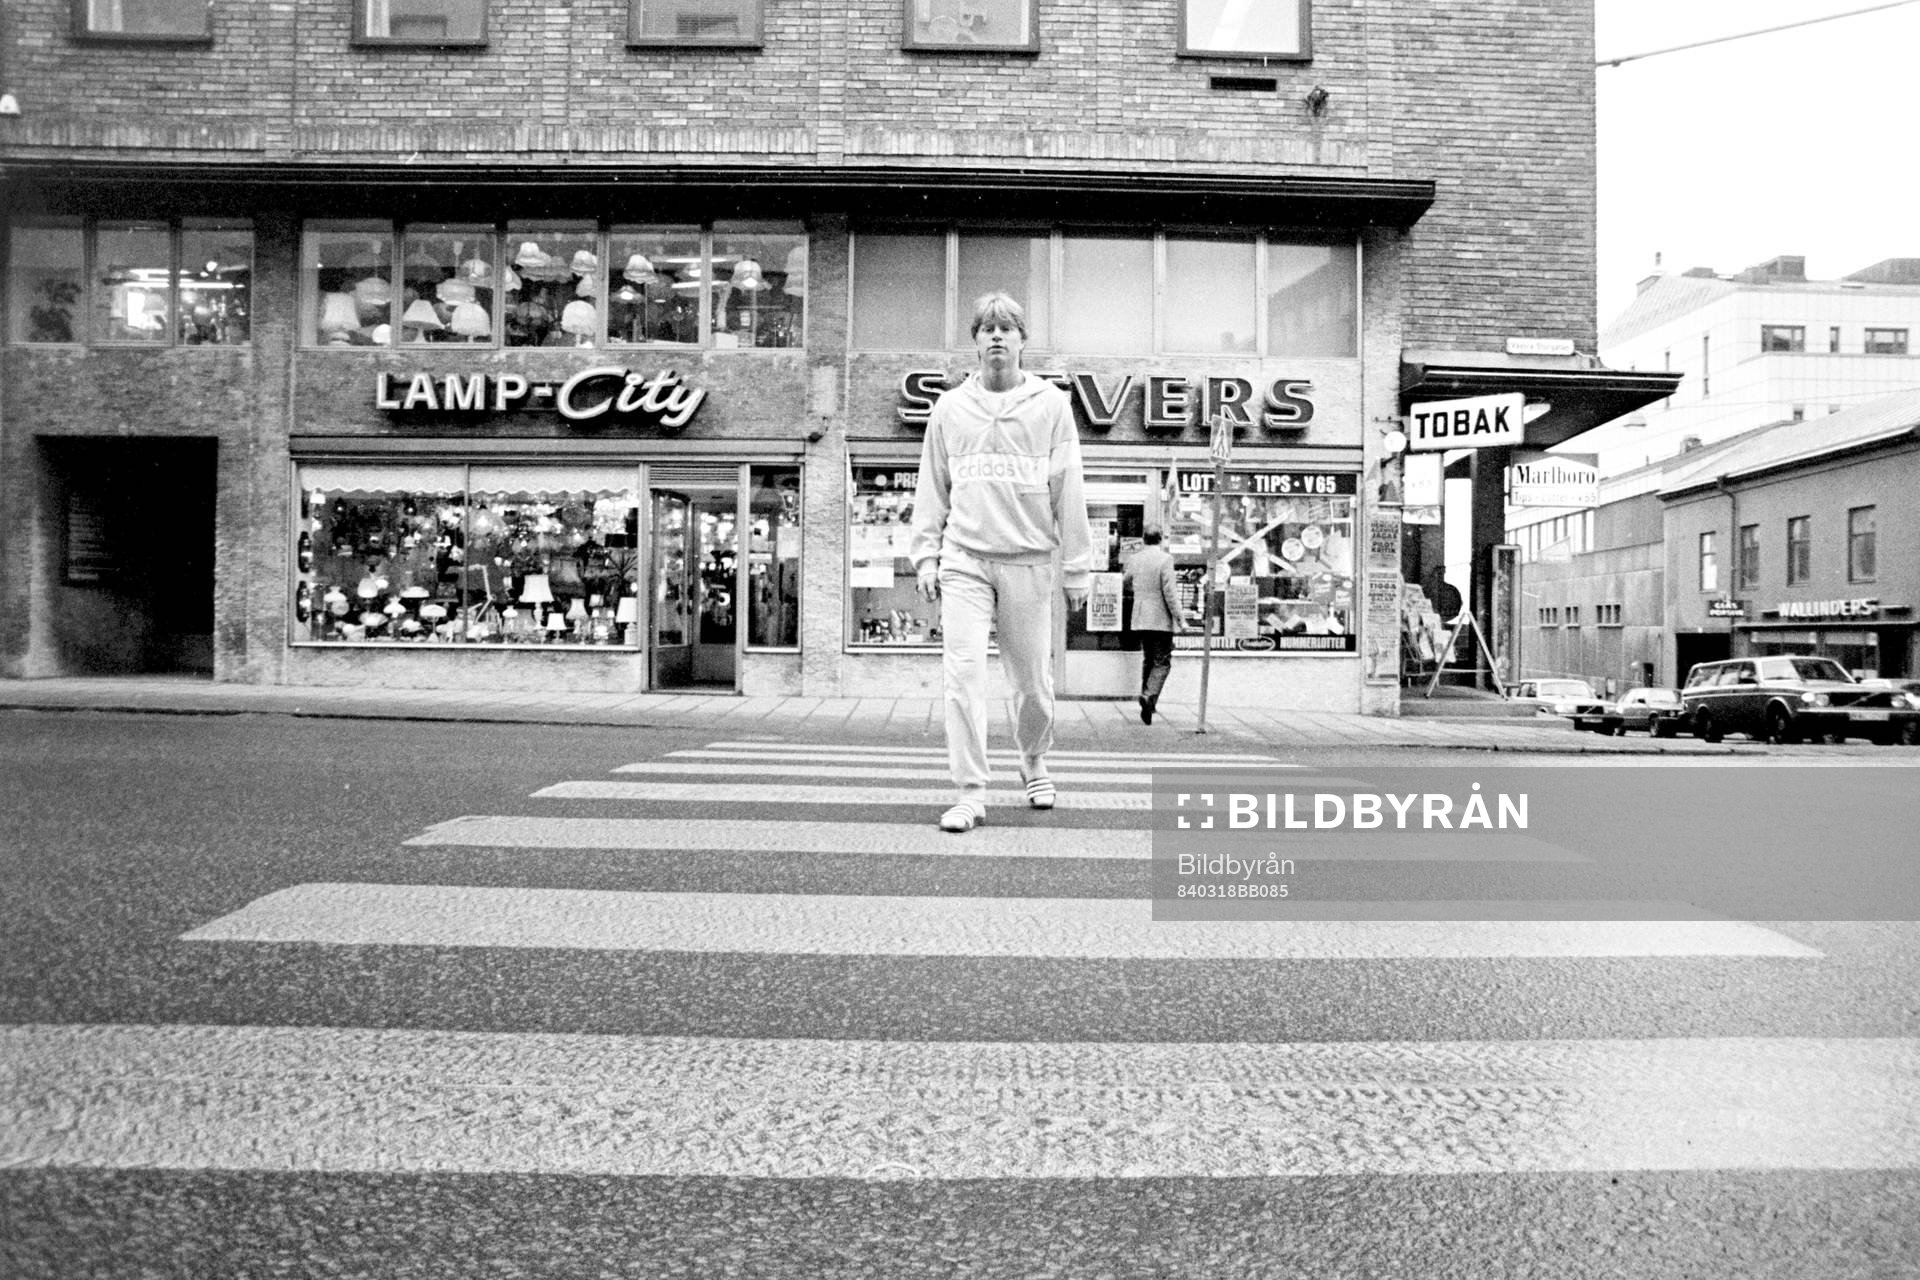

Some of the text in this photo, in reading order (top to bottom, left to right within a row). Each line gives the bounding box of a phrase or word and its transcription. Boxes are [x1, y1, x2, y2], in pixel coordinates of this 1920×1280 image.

[375, 366, 706, 427] LAMP-City
[897, 371, 1314, 428] SVERS
[1415, 405, 1510, 439] TOBAK
[894, 472, 918, 489] PRE
[1254, 475, 1291, 492] TIPS
[1304, 476, 1336, 493] V65
[1515, 465, 1596, 484] Marlboro
